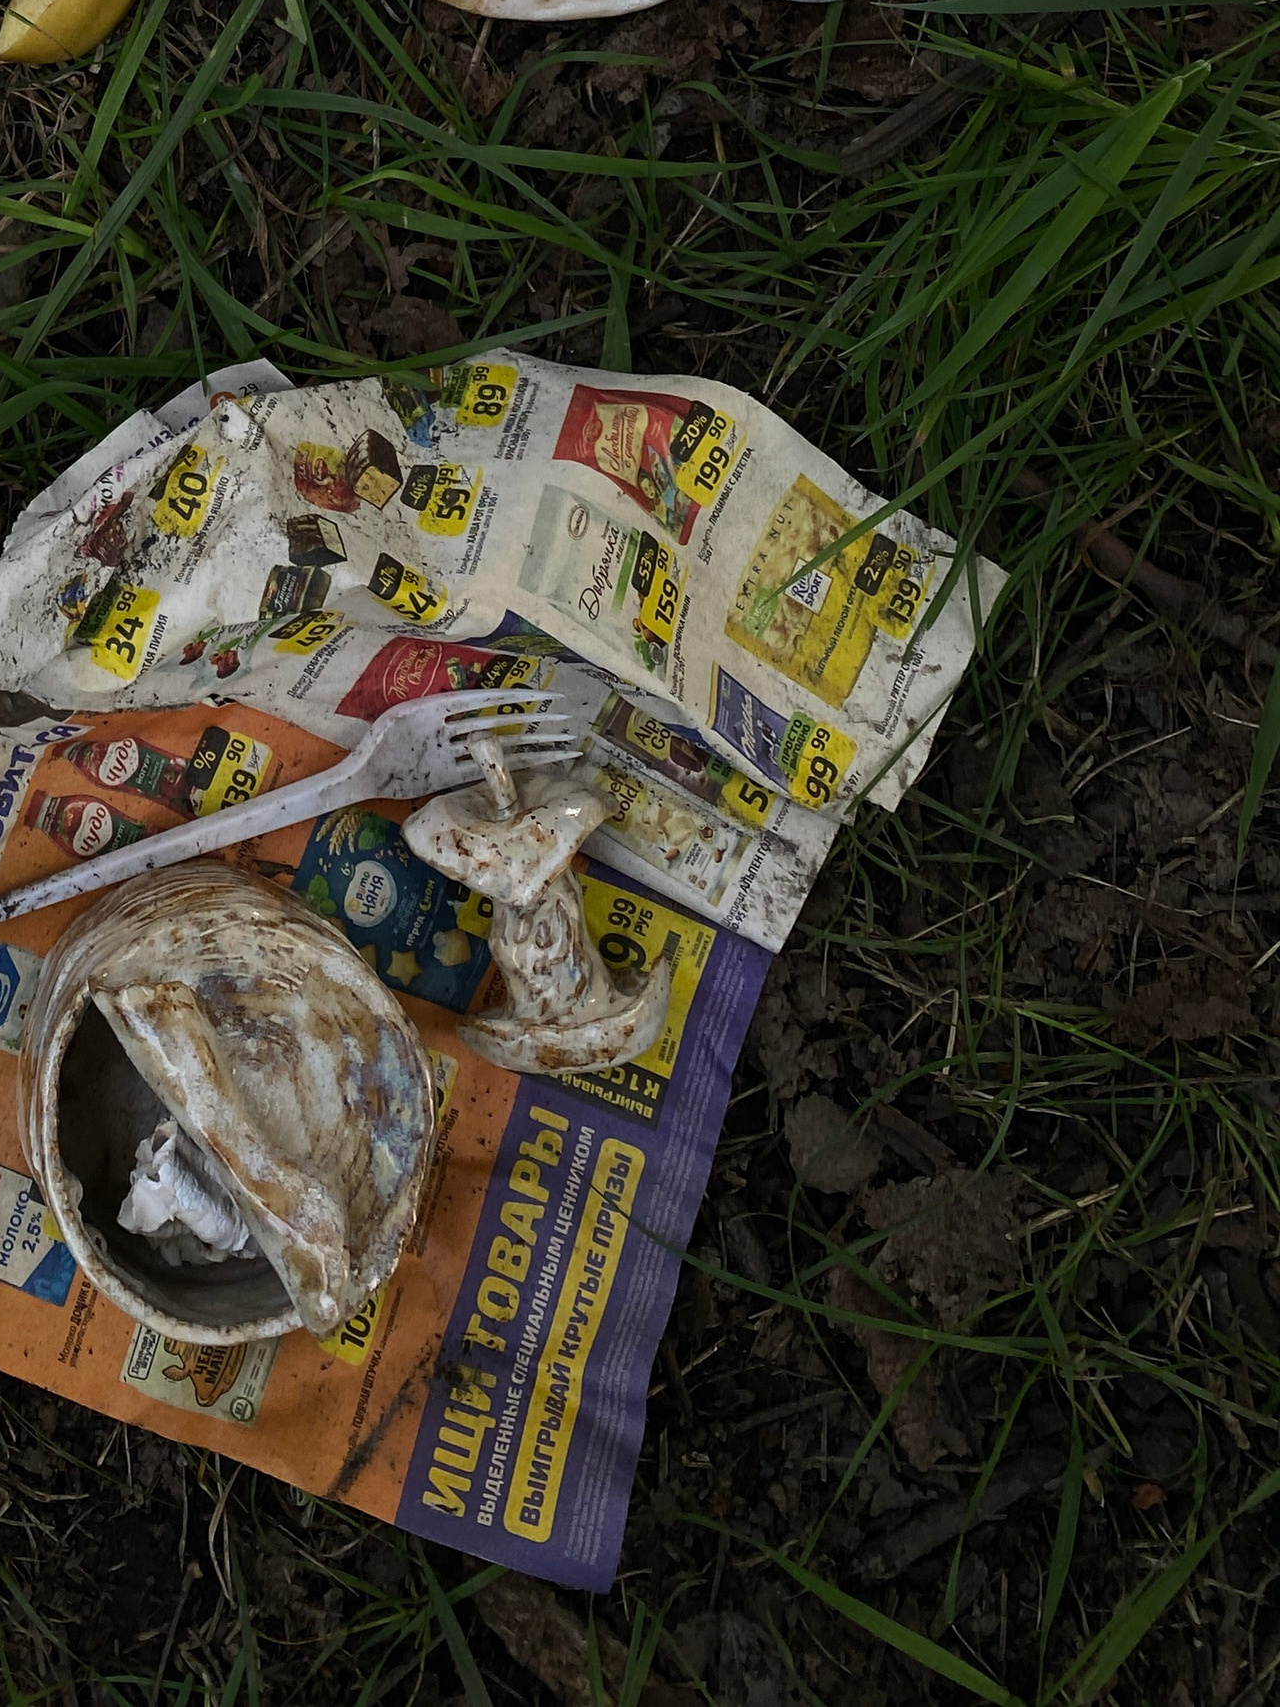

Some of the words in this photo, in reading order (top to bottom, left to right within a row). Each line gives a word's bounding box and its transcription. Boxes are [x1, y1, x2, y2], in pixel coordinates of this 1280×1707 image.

[239, 383, 259, 397] 29
[473, 366, 489, 382] 99
[473, 384, 506, 416] 89
[680, 416, 708, 455] -20%
[709, 416, 727, 440] 90
[437, 468, 453, 486] 99
[694, 446, 730, 491] 199
[169, 472, 208, 521] 40
[436, 488, 470, 520] 59
[697, 524, 714, 560] Конфеты
[708, 486, 733, 526] ЛЮБИМЫЕ
[455, 543, 474, 575] Конфеты
[466, 519, 481, 544] ХАЛВА
[658, 548, 669, 572] 90
[735, 552, 768, 611] EXTRA
[769, 502, 794, 540] NUT
[894, 549, 912, 572] 90
[404, 570, 419, 586] 99
[579, 526, 620, 620] Добрянка
[638, 548, 655, 589] -53%
[117, 591, 137, 611] 99
[392, 590, 438, 621] 54
[655, 579, 678, 625] 159
[805, 573, 823, 607] SPORT
[886, 578, 921, 624] 139
[106, 616, 144, 663] 34
[148, 613, 168, 651] ЛИЛИЯ
[297, 624, 335, 647] 49
[673, 620, 687, 664] ДОБРЯНКА
[816, 633, 839, 677] ЦЕЛЬНЫЙ
[832, 601, 849, 641] ЛЕСНОЙ
[511, 660, 530, 679] 99
[874, 698, 898, 735] Шоколад
[888, 670, 907, 698] РИТТЕР
[226, 738, 246, 763] 90
[651, 728, 671, 751] Go
[782, 719, 803, 764] ПРОСТО
[811, 727, 830, 752] 99
[106, 738, 133, 783] Чудо
[135, 753, 152, 785] ЙОГУРТ
[806, 755, 838, 803] 99
[80, 806, 106, 852] Чудо
[361, 875, 384, 917] НЯНЯ
[719, 889, 746, 928] Шоколад
[736, 852, 763, 893] АЛЬПЕН
[406, 915, 426, 947] перед
[608, 898, 637, 929] 99
[633, 908, 653, 938] РУБ
[562, 1073, 653, 1119] ВЫИГРЫВАЙ
[629, 1074, 638, 1091] 1
[644, 1079, 660, 1100] К
[23, 1212, 43, 1254] 2,5%
[58, 1325, 76, 1364] Молоко
[70, 1289, 89, 1326] ДОМИК
[422, 1363, 497, 1518] ИЩИ
[463, 1105, 570, 1353] ТОВАРЫ
[477, 1387, 523, 1527] ВЫДЕЛЕННЫЕ
[511, 1234, 565, 1386] СПЕЦИАЛЬНЫМ
[554, 1125, 596, 1236] ЦЕННИКОМ
[519, 1362, 572, 1527] ВЫИГРЫВАЙ
[558, 1249, 607, 1359] КРУТЫЕ
[591, 1151, 633, 1248] ПРИЗЫ
[352, 1385, 371, 1430] ГОРЯЧАЯ
[363, 1349, 383, 1391] ШТУЧКА
